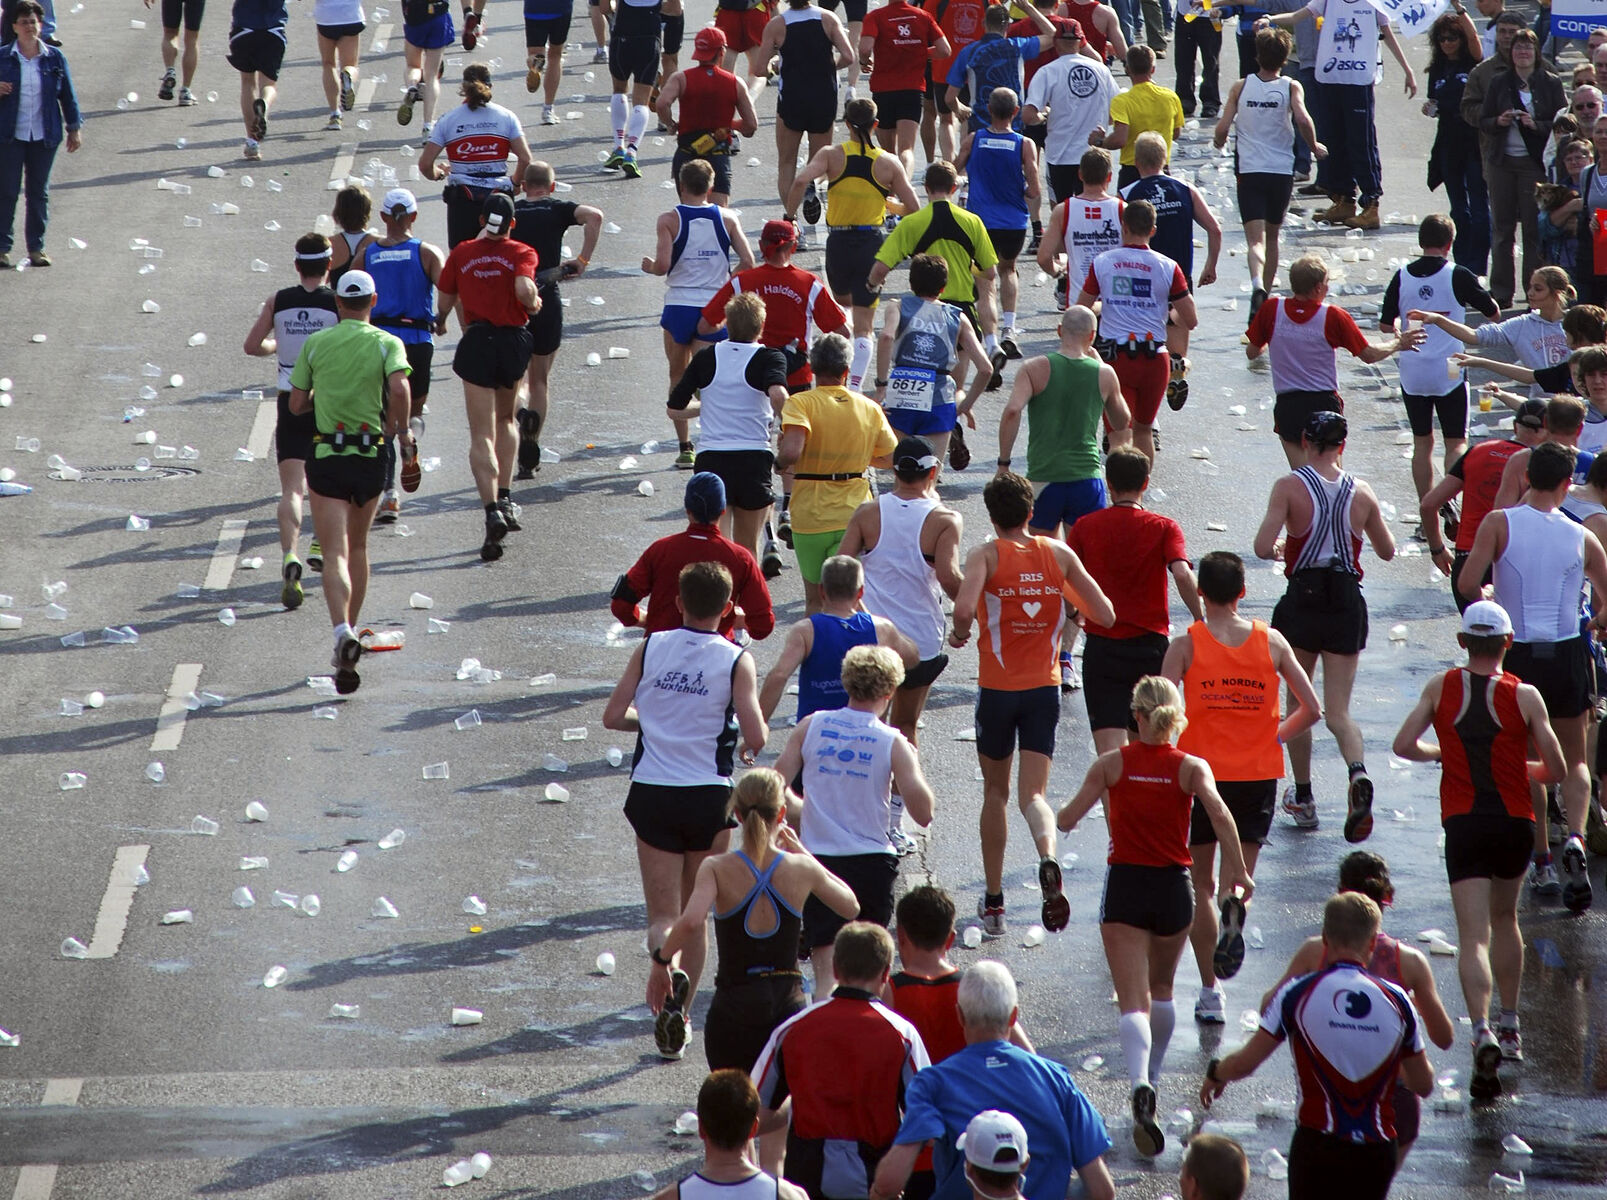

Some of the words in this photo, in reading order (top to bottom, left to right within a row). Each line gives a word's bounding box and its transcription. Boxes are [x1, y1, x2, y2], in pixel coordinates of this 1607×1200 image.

[764, 284, 802, 304] Haldern
[912, 317, 946, 334] DAV
[892, 378, 928, 392] 6612
[1020, 572, 1044, 582] IRIS
[998, 587, 1016, 597] Ich
[1018, 586, 1042, 596] liebe
[1044, 585, 1063, 596] Dic
[665, 671, 689, 684] SFB
[1201, 679, 1215, 689] TV
[1222, 678, 1266, 691] NORDEN
